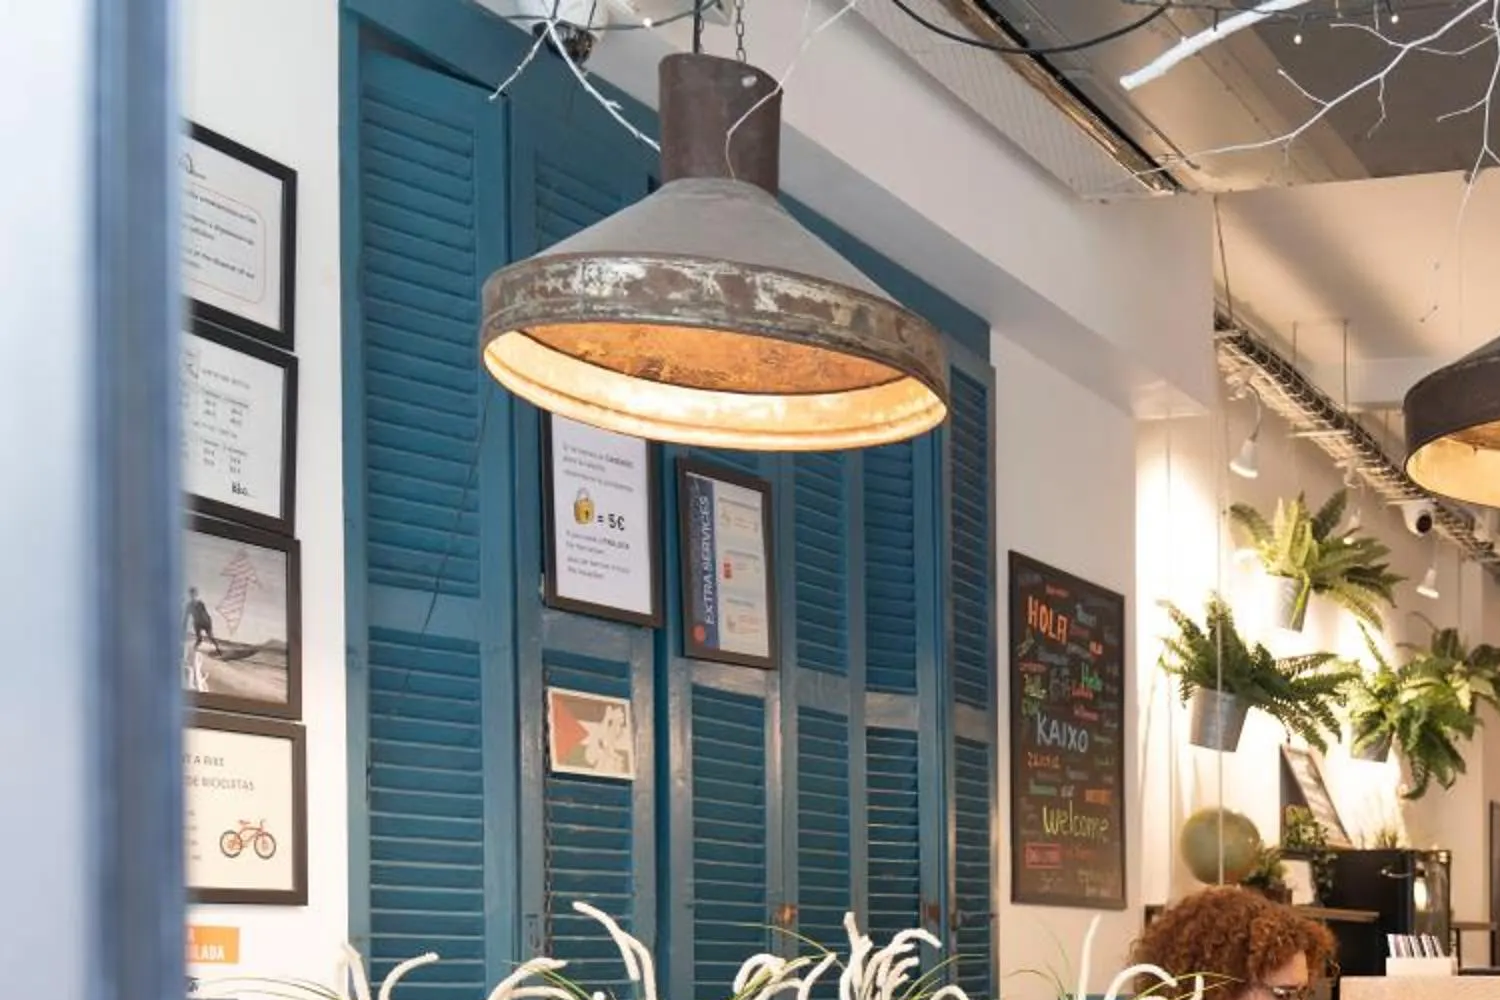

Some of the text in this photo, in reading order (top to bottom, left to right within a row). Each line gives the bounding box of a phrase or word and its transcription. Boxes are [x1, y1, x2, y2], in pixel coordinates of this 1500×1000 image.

[607, 512, 625, 531] 5€
[699, 495, 715, 625] EXTRA SERVICES
[1027, 595, 1068, 645] HOLA
[1037, 711, 1090, 753] KAIXO
[1043, 799, 1110, 843] Welcome
